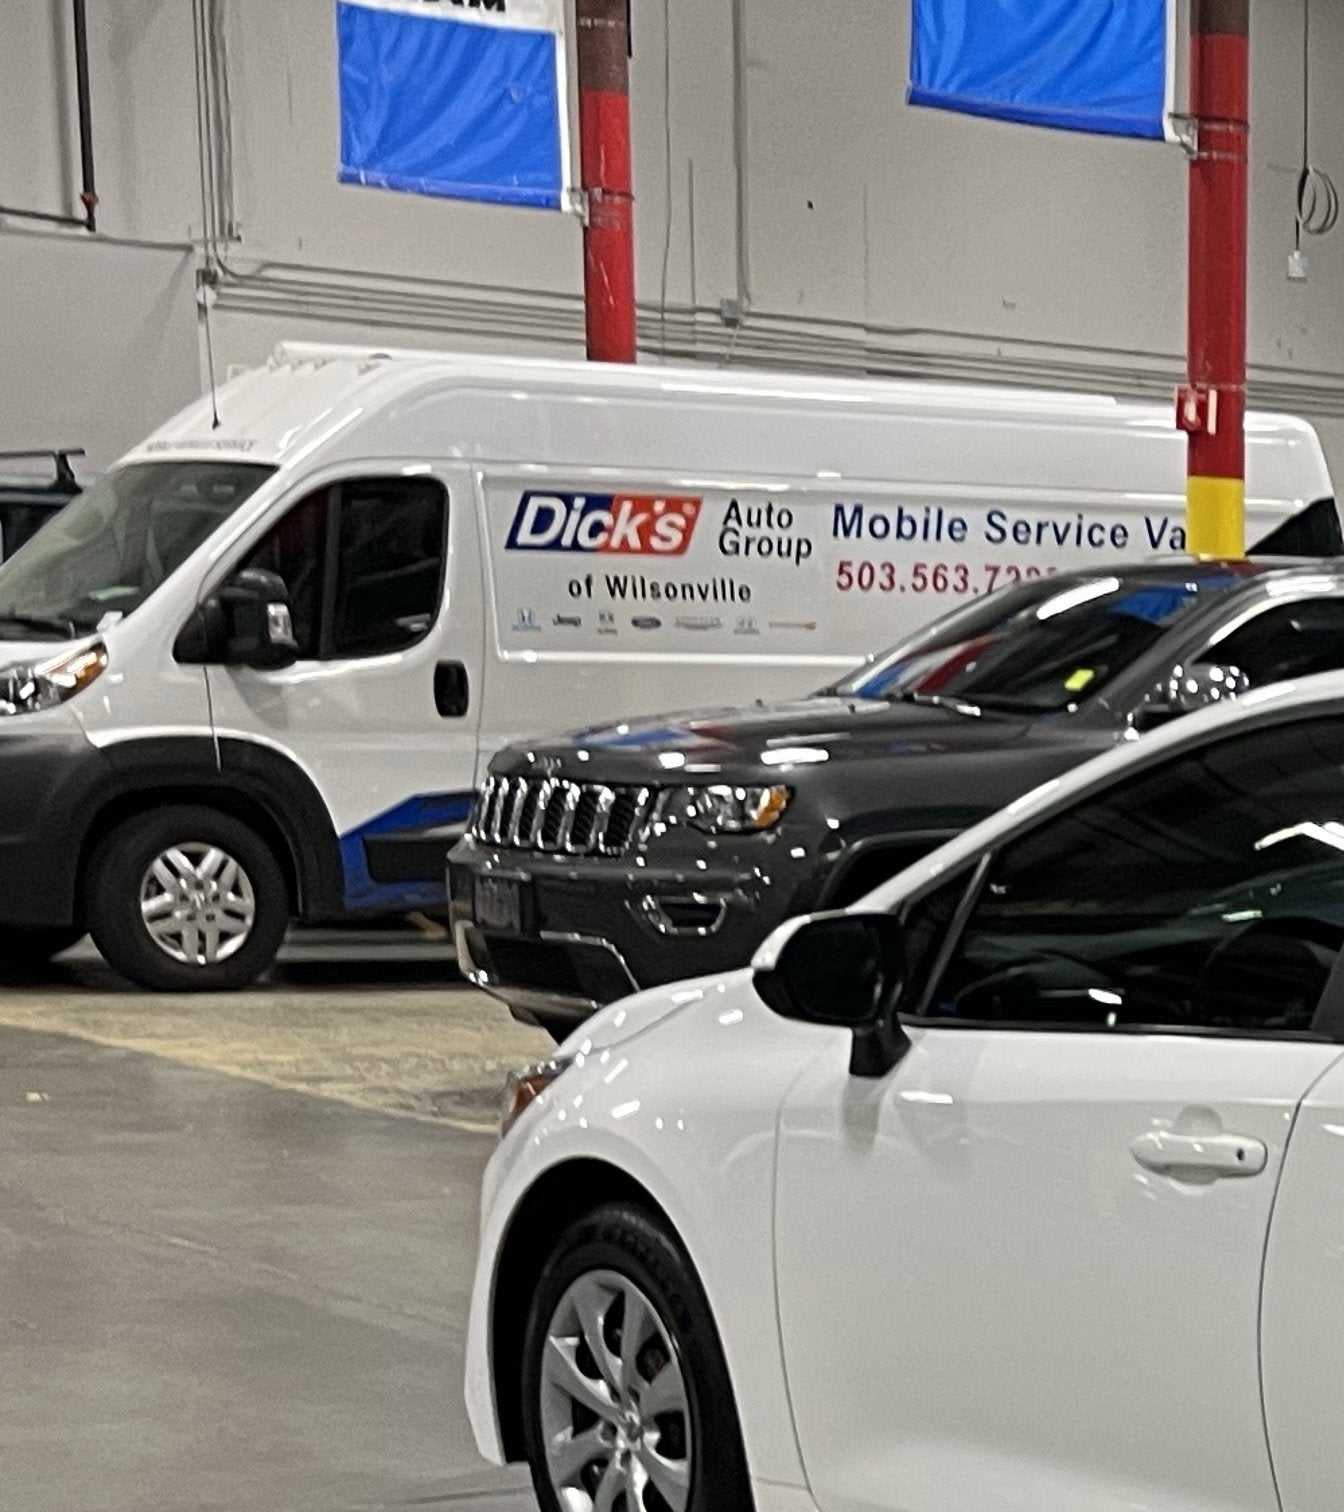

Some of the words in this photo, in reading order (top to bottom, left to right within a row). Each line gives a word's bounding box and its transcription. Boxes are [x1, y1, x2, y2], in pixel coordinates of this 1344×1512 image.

[515, 495, 687, 551] Dick's
[721, 498, 794, 529] Auto
[832, 503, 969, 543] Mobile
[984, 509, 1130, 549] Service
[718, 526, 813, 567] Group
[568, 574, 592, 599] of
[604, 574, 752, 604] Wilsonville
